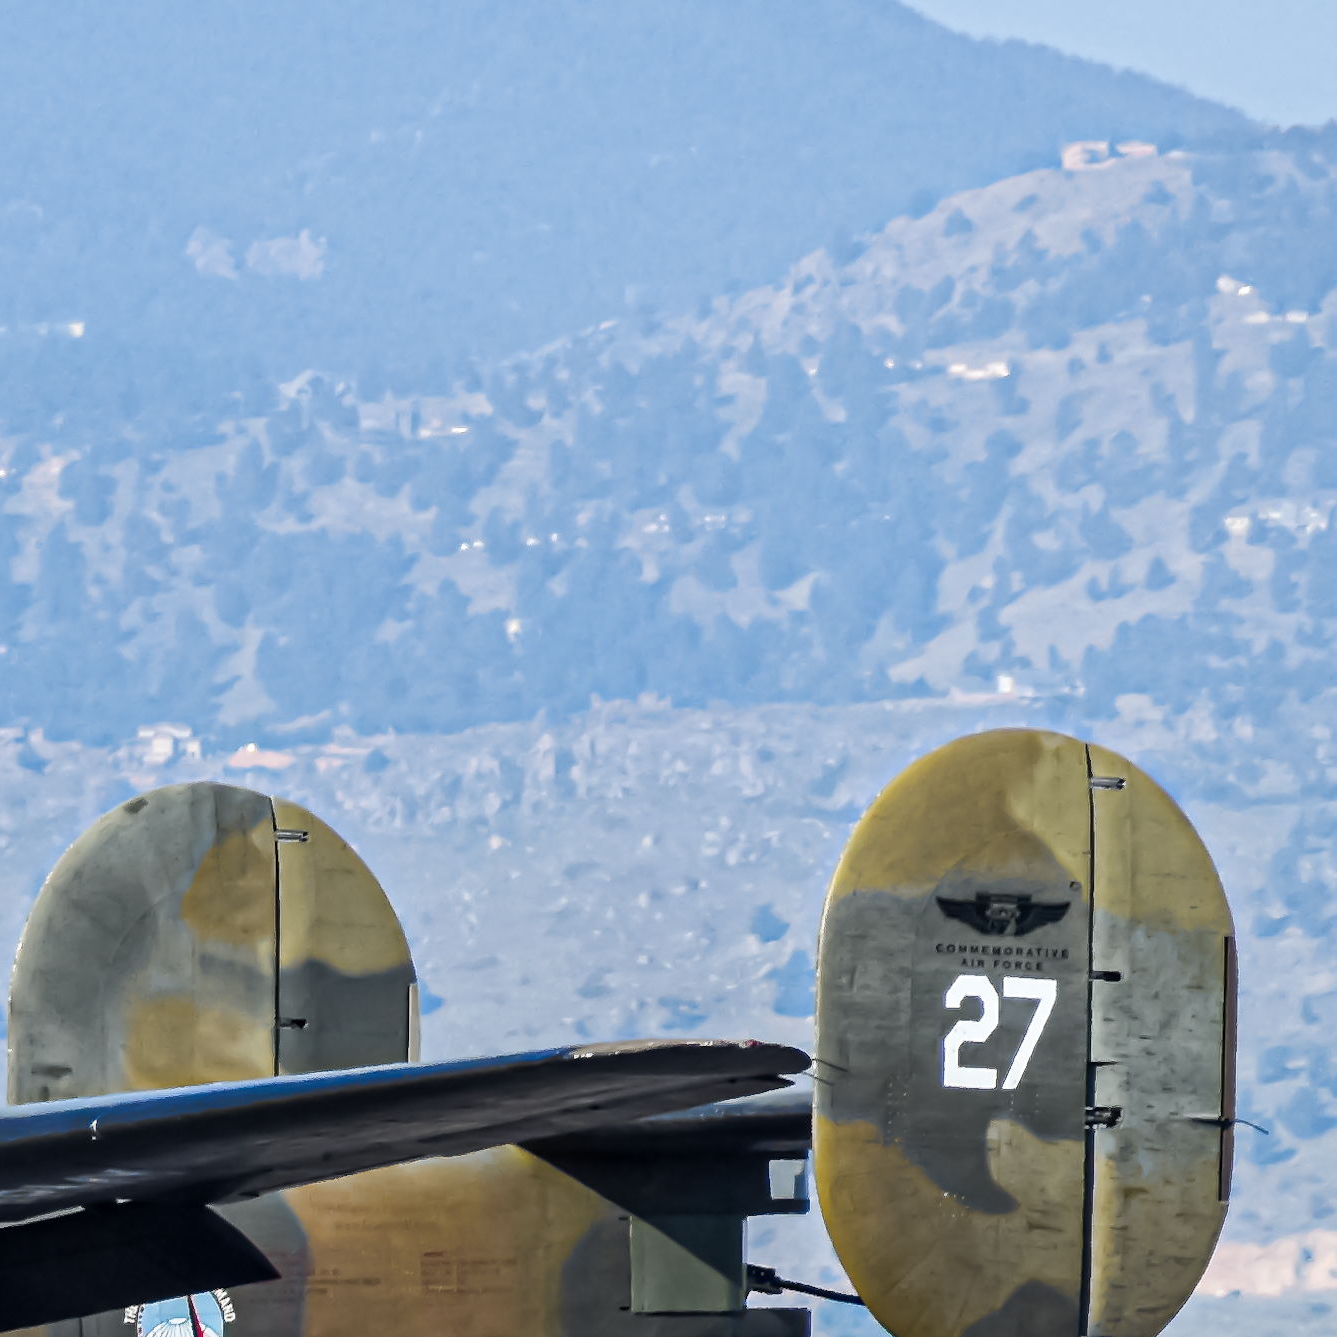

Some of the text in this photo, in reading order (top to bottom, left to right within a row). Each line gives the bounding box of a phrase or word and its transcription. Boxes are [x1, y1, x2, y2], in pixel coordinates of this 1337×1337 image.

[935, 943, 1069, 959] COMMEMORATIVE
[960, 958, 1043, 971] AIR FORCE
[940, 973, 1058, 1091] 27
[214, 1288, 236, 1323] MAND
